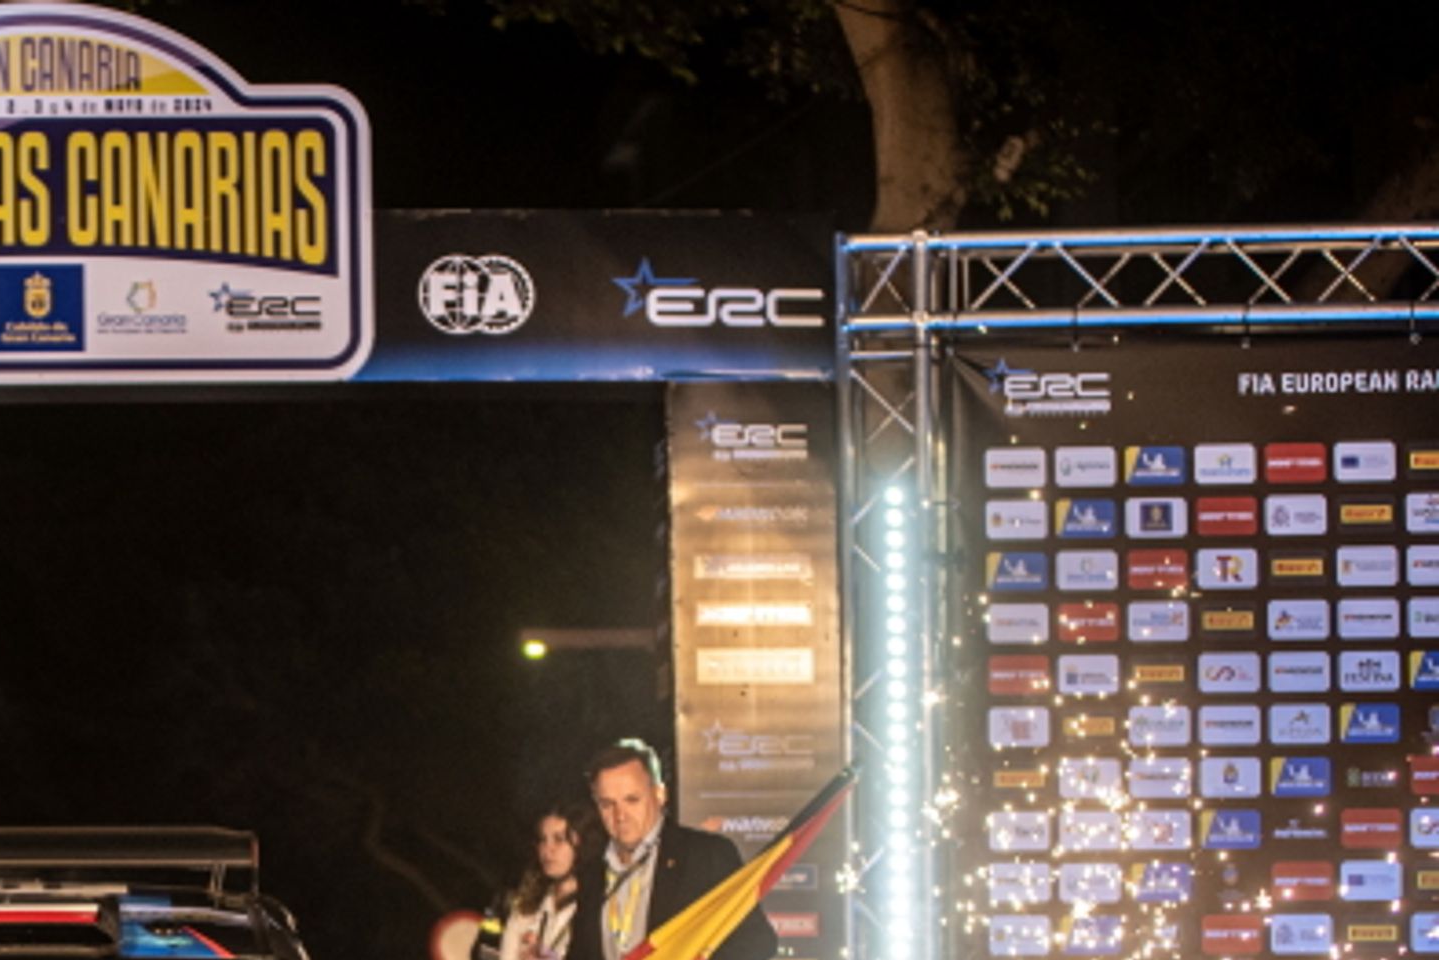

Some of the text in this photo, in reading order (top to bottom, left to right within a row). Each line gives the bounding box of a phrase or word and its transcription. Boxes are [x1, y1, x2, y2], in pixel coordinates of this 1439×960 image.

[21, 37, 141, 92] CANARIA
[67, 129, 327, 265] CANARIAS
[227, 296, 321, 316] ERC
[646, 288, 824, 326] ERC
[1004, 373, 1111, 397] ERC
[1237, 372, 1276, 395] FIA
[1281, 370, 1398, 393] EUROPEAN
[713, 424, 808, 447] ERC
